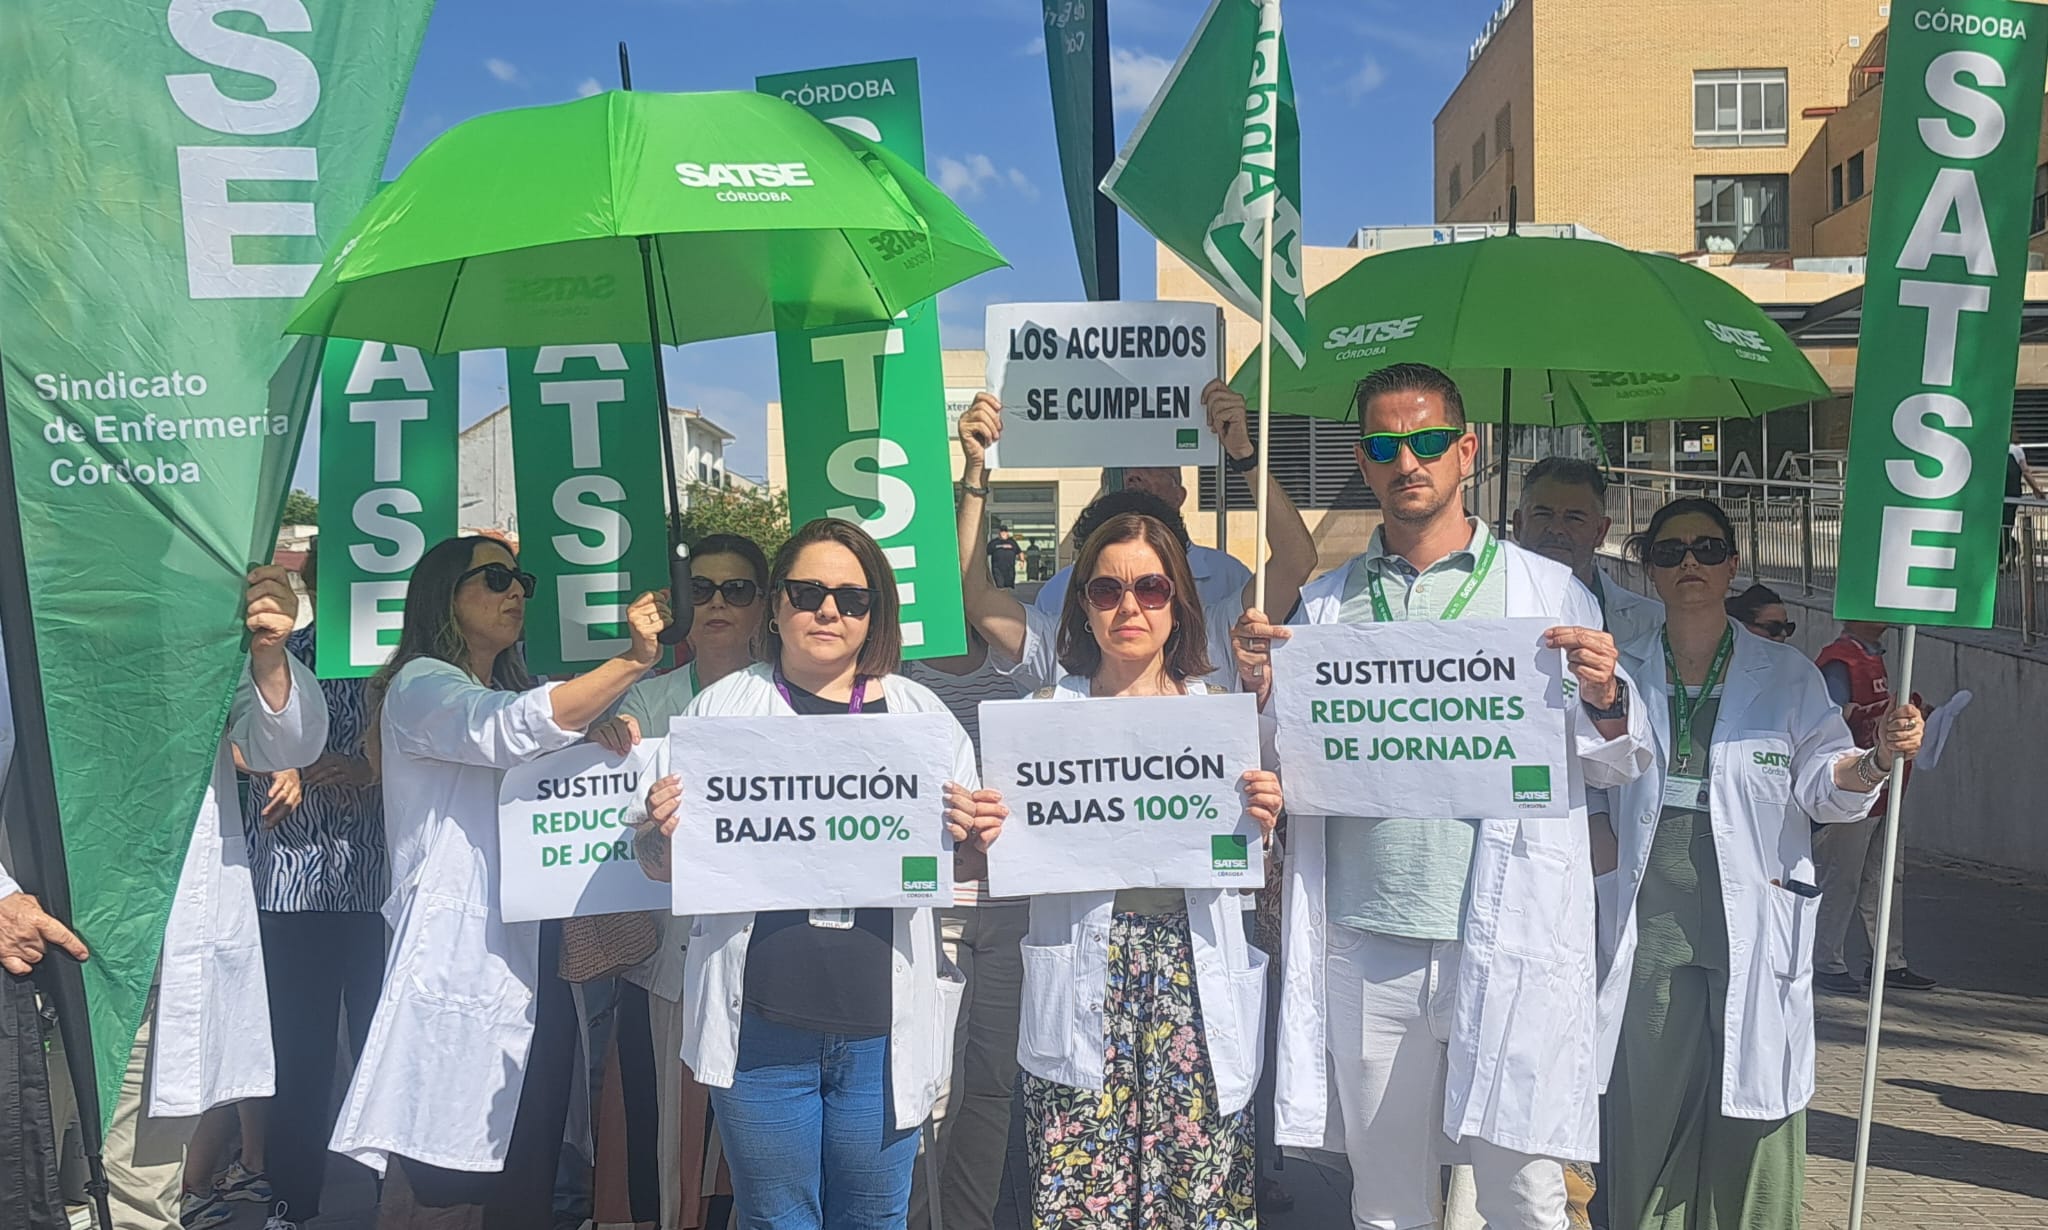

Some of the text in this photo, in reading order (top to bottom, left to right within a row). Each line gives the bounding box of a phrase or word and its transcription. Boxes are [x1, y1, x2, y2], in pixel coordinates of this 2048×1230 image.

[1915, 7, 2027, 40] CÓRDOBA
[781, 78, 896, 106] CÓRDOBA
[675, 162, 815, 188] SATSE
[716, 189, 792, 202] CÓRDOBA
[1010, 325, 1206, 360] LOS ACUERDOS
[1324, 315, 1423, 349] SATSE
[1704, 320, 1772, 352] SATSE
[1875, 51, 2006, 613] SATSE
[1335, 346, 1386, 360] CÓRDOBA
[34, 371, 208, 403] Sindicato
[1027, 386, 1190, 421] SE CUMPLEN
[43, 408, 289, 444] de Enfermería
[49, 454, 201, 487] Córdoba
[1315, 649, 1516, 685] SUSTITUCIÓN
[1311, 696, 1525, 724] REDUCCIONES
[1324, 735, 1516, 761] DE JORNADA
[1016, 747, 1225, 787] SUSTITUCIÓN
[706, 766, 918, 802] SUSTITUCIÓN
[1514, 791, 1550, 800] SATSE
[1025, 794, 1219, 827] BAJAS 100%
[714, 814, 911, 843] BAJAS 100%
[542, 844, 573, 867] DE
[1214, 859, 1248, 868] SATSE
[903, 881, 937, 889] SATSE
